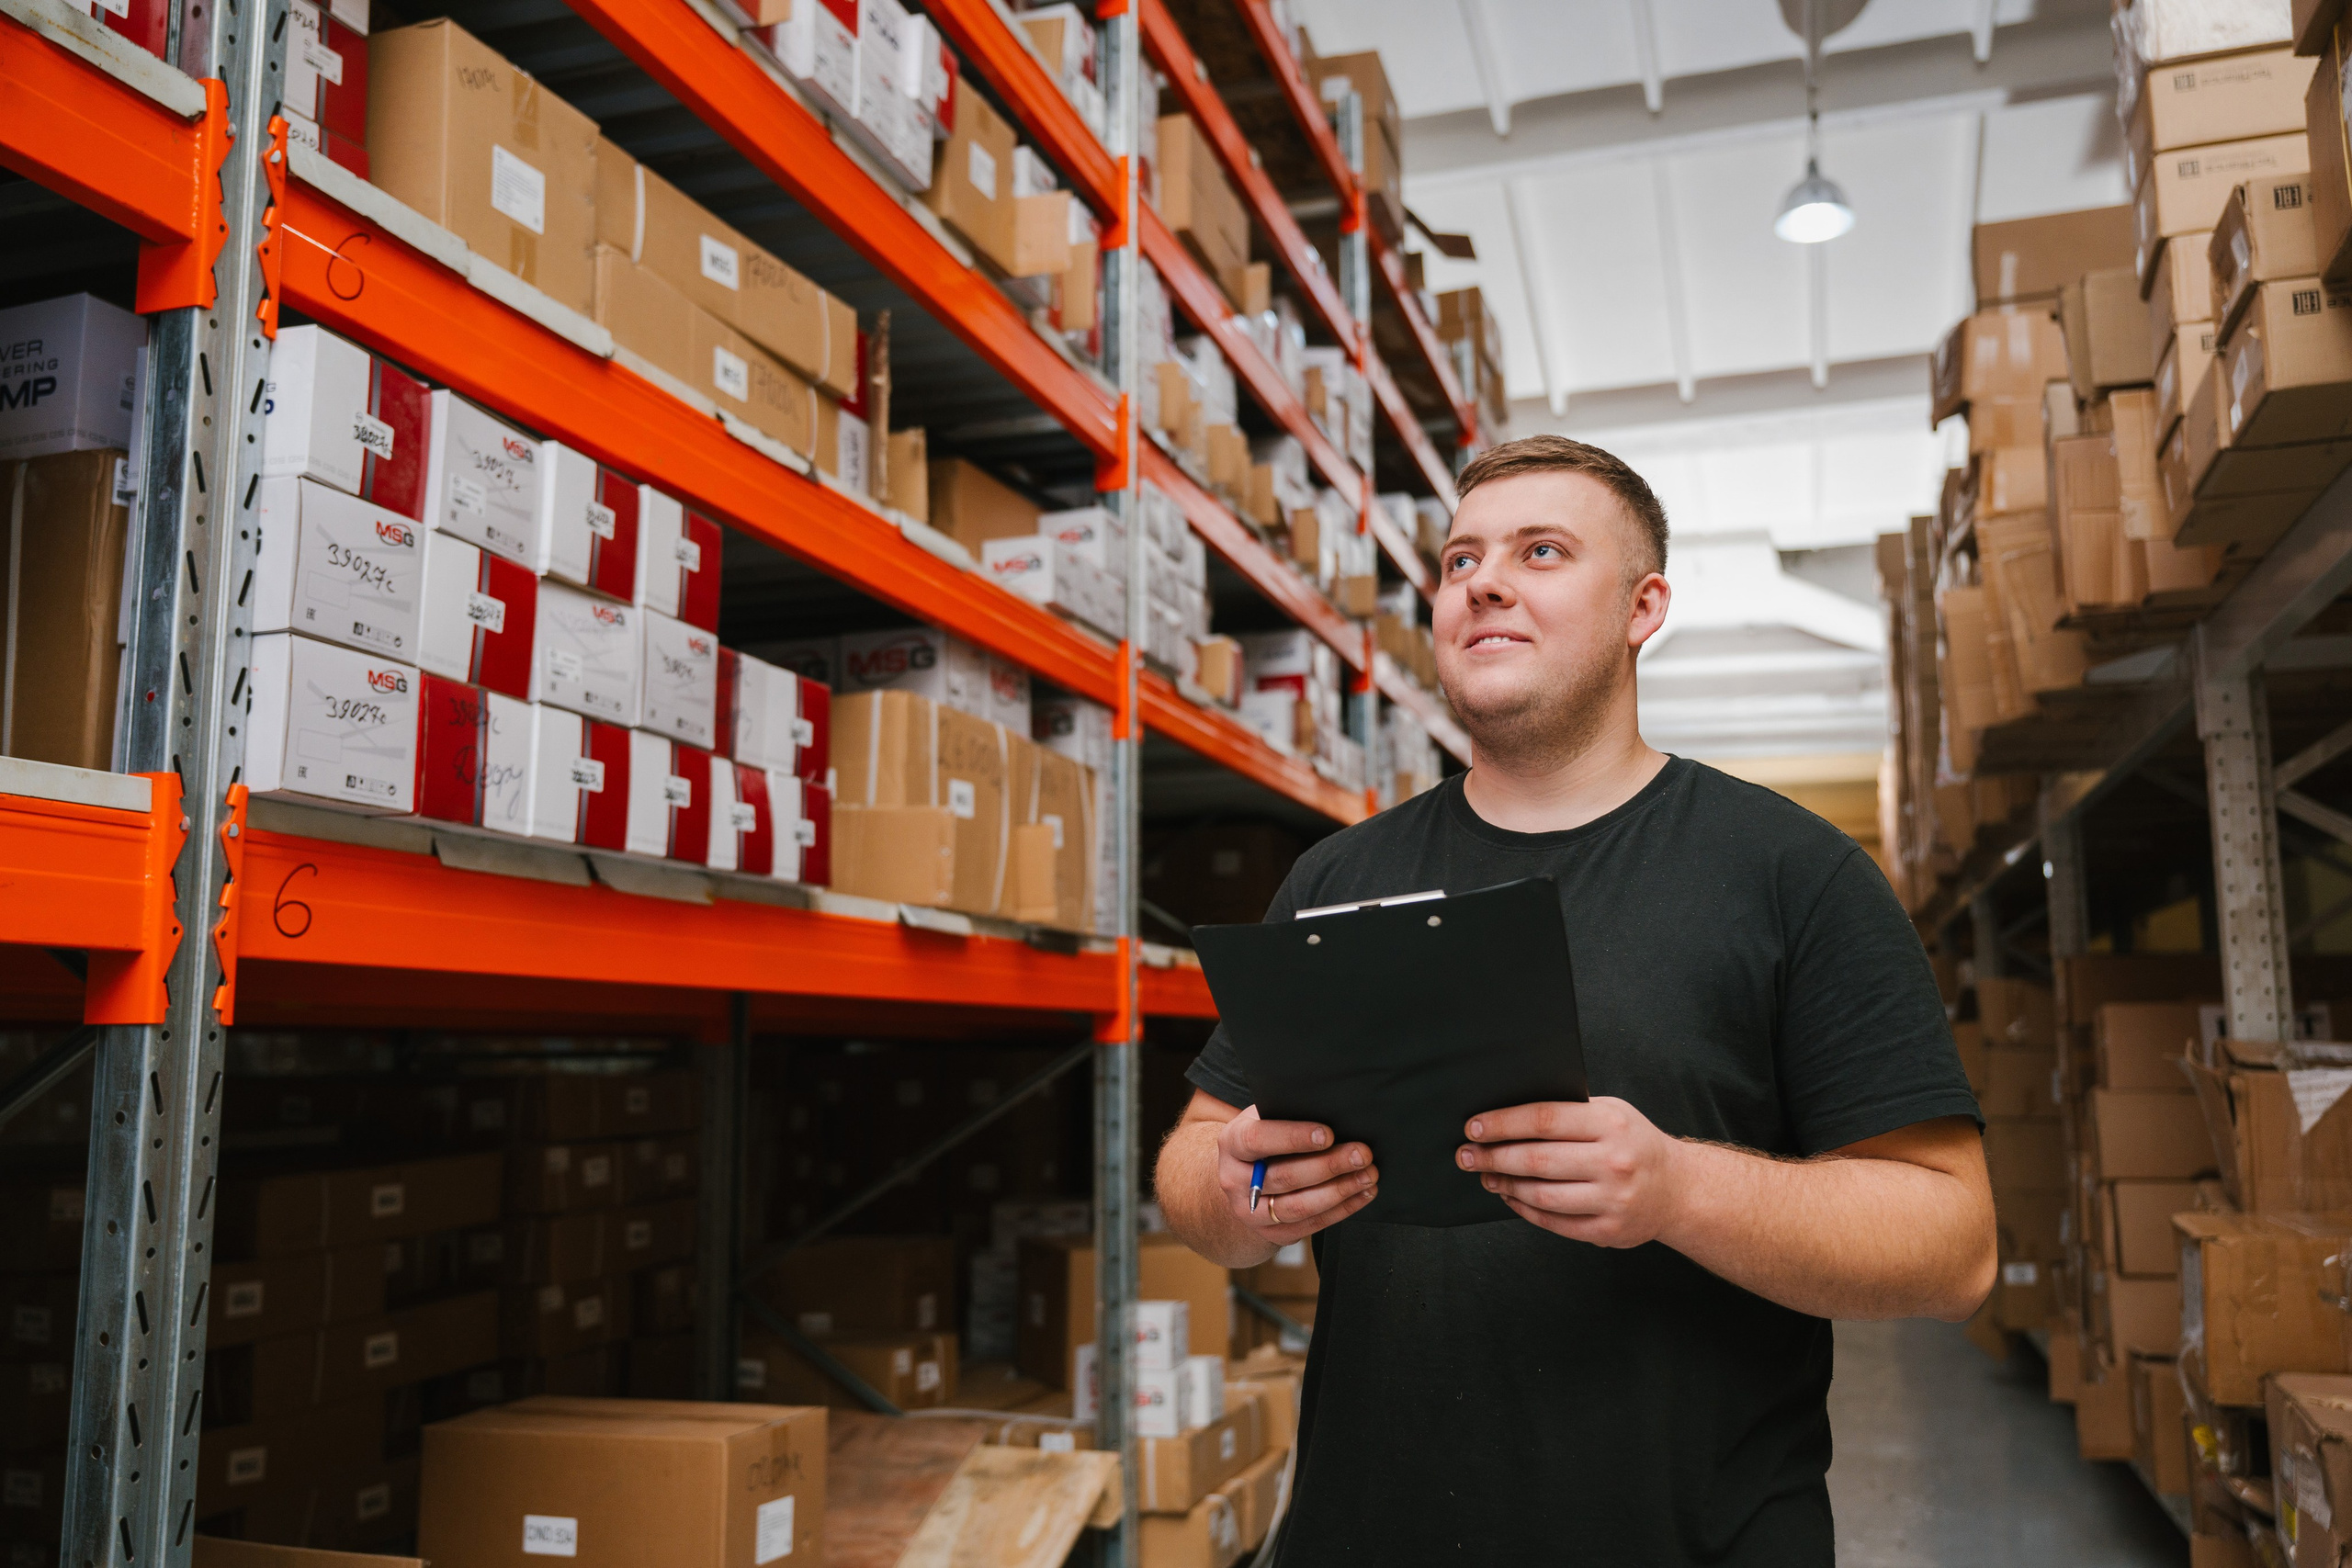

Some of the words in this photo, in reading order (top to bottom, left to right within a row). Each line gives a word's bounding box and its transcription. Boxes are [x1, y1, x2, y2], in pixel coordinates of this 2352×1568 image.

[327, 232, 371, 301] 6
[503, 437, 534, 463] MSG
[376, 521, 414, 548] MSG
[993, 558, 1042, 574] MSG
[593, 604, 626, 626] MSG
[848, 645, 935, 675] MSG
[368, 670, 408, 694] MSG
[274, 863, 318, 939] 6
